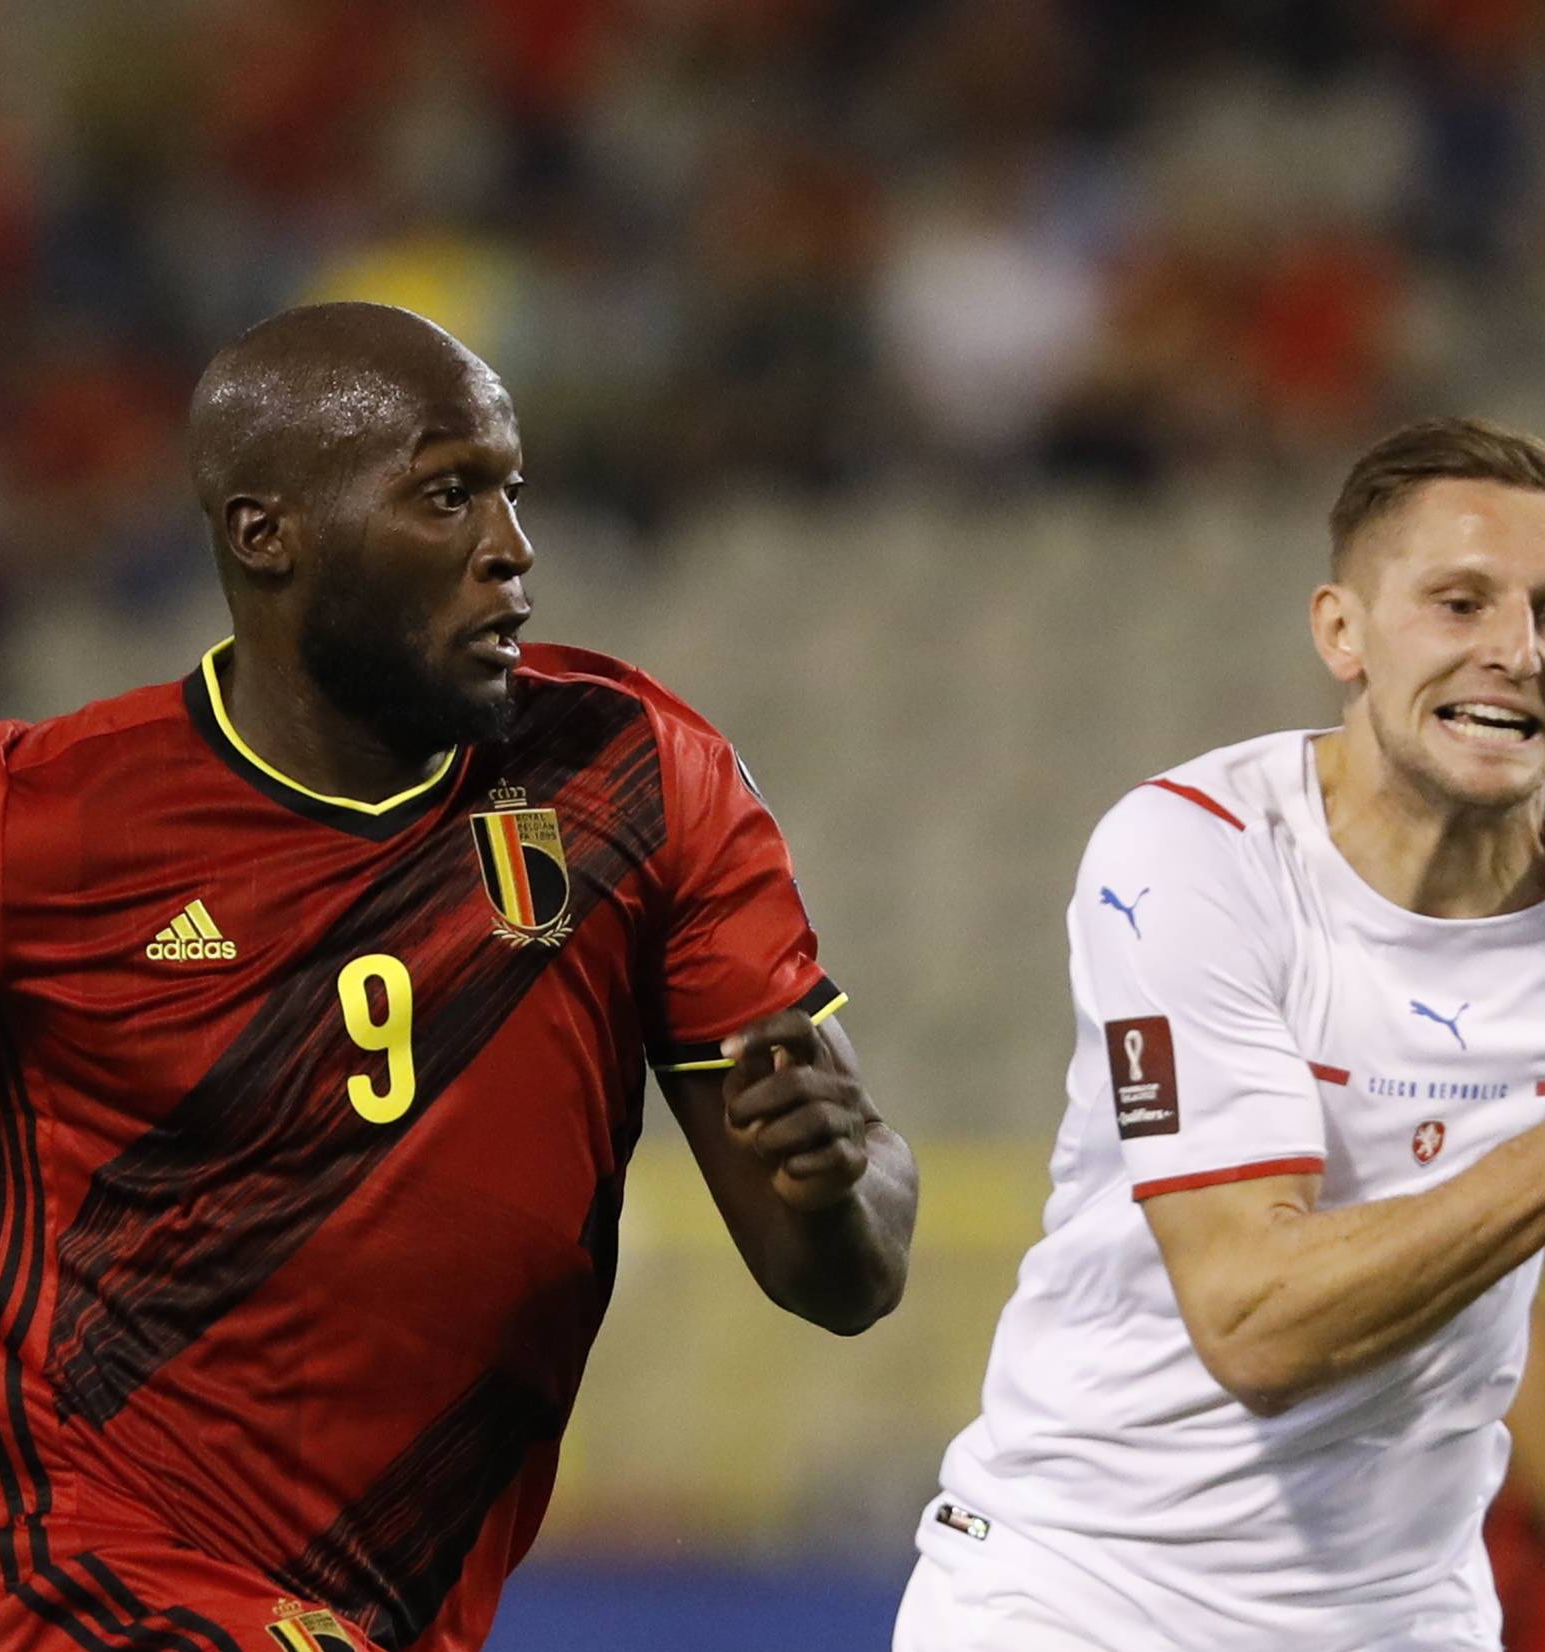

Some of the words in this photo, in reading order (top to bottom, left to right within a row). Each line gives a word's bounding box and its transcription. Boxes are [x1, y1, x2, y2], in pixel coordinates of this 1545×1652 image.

[146, 938, 236, 961] adidas
[337, 953, 415, 1124] 9
[1368, 1077, 1417, 1098] CZECH
[1428, 1082, 1509, 1100] REPUBLIC
